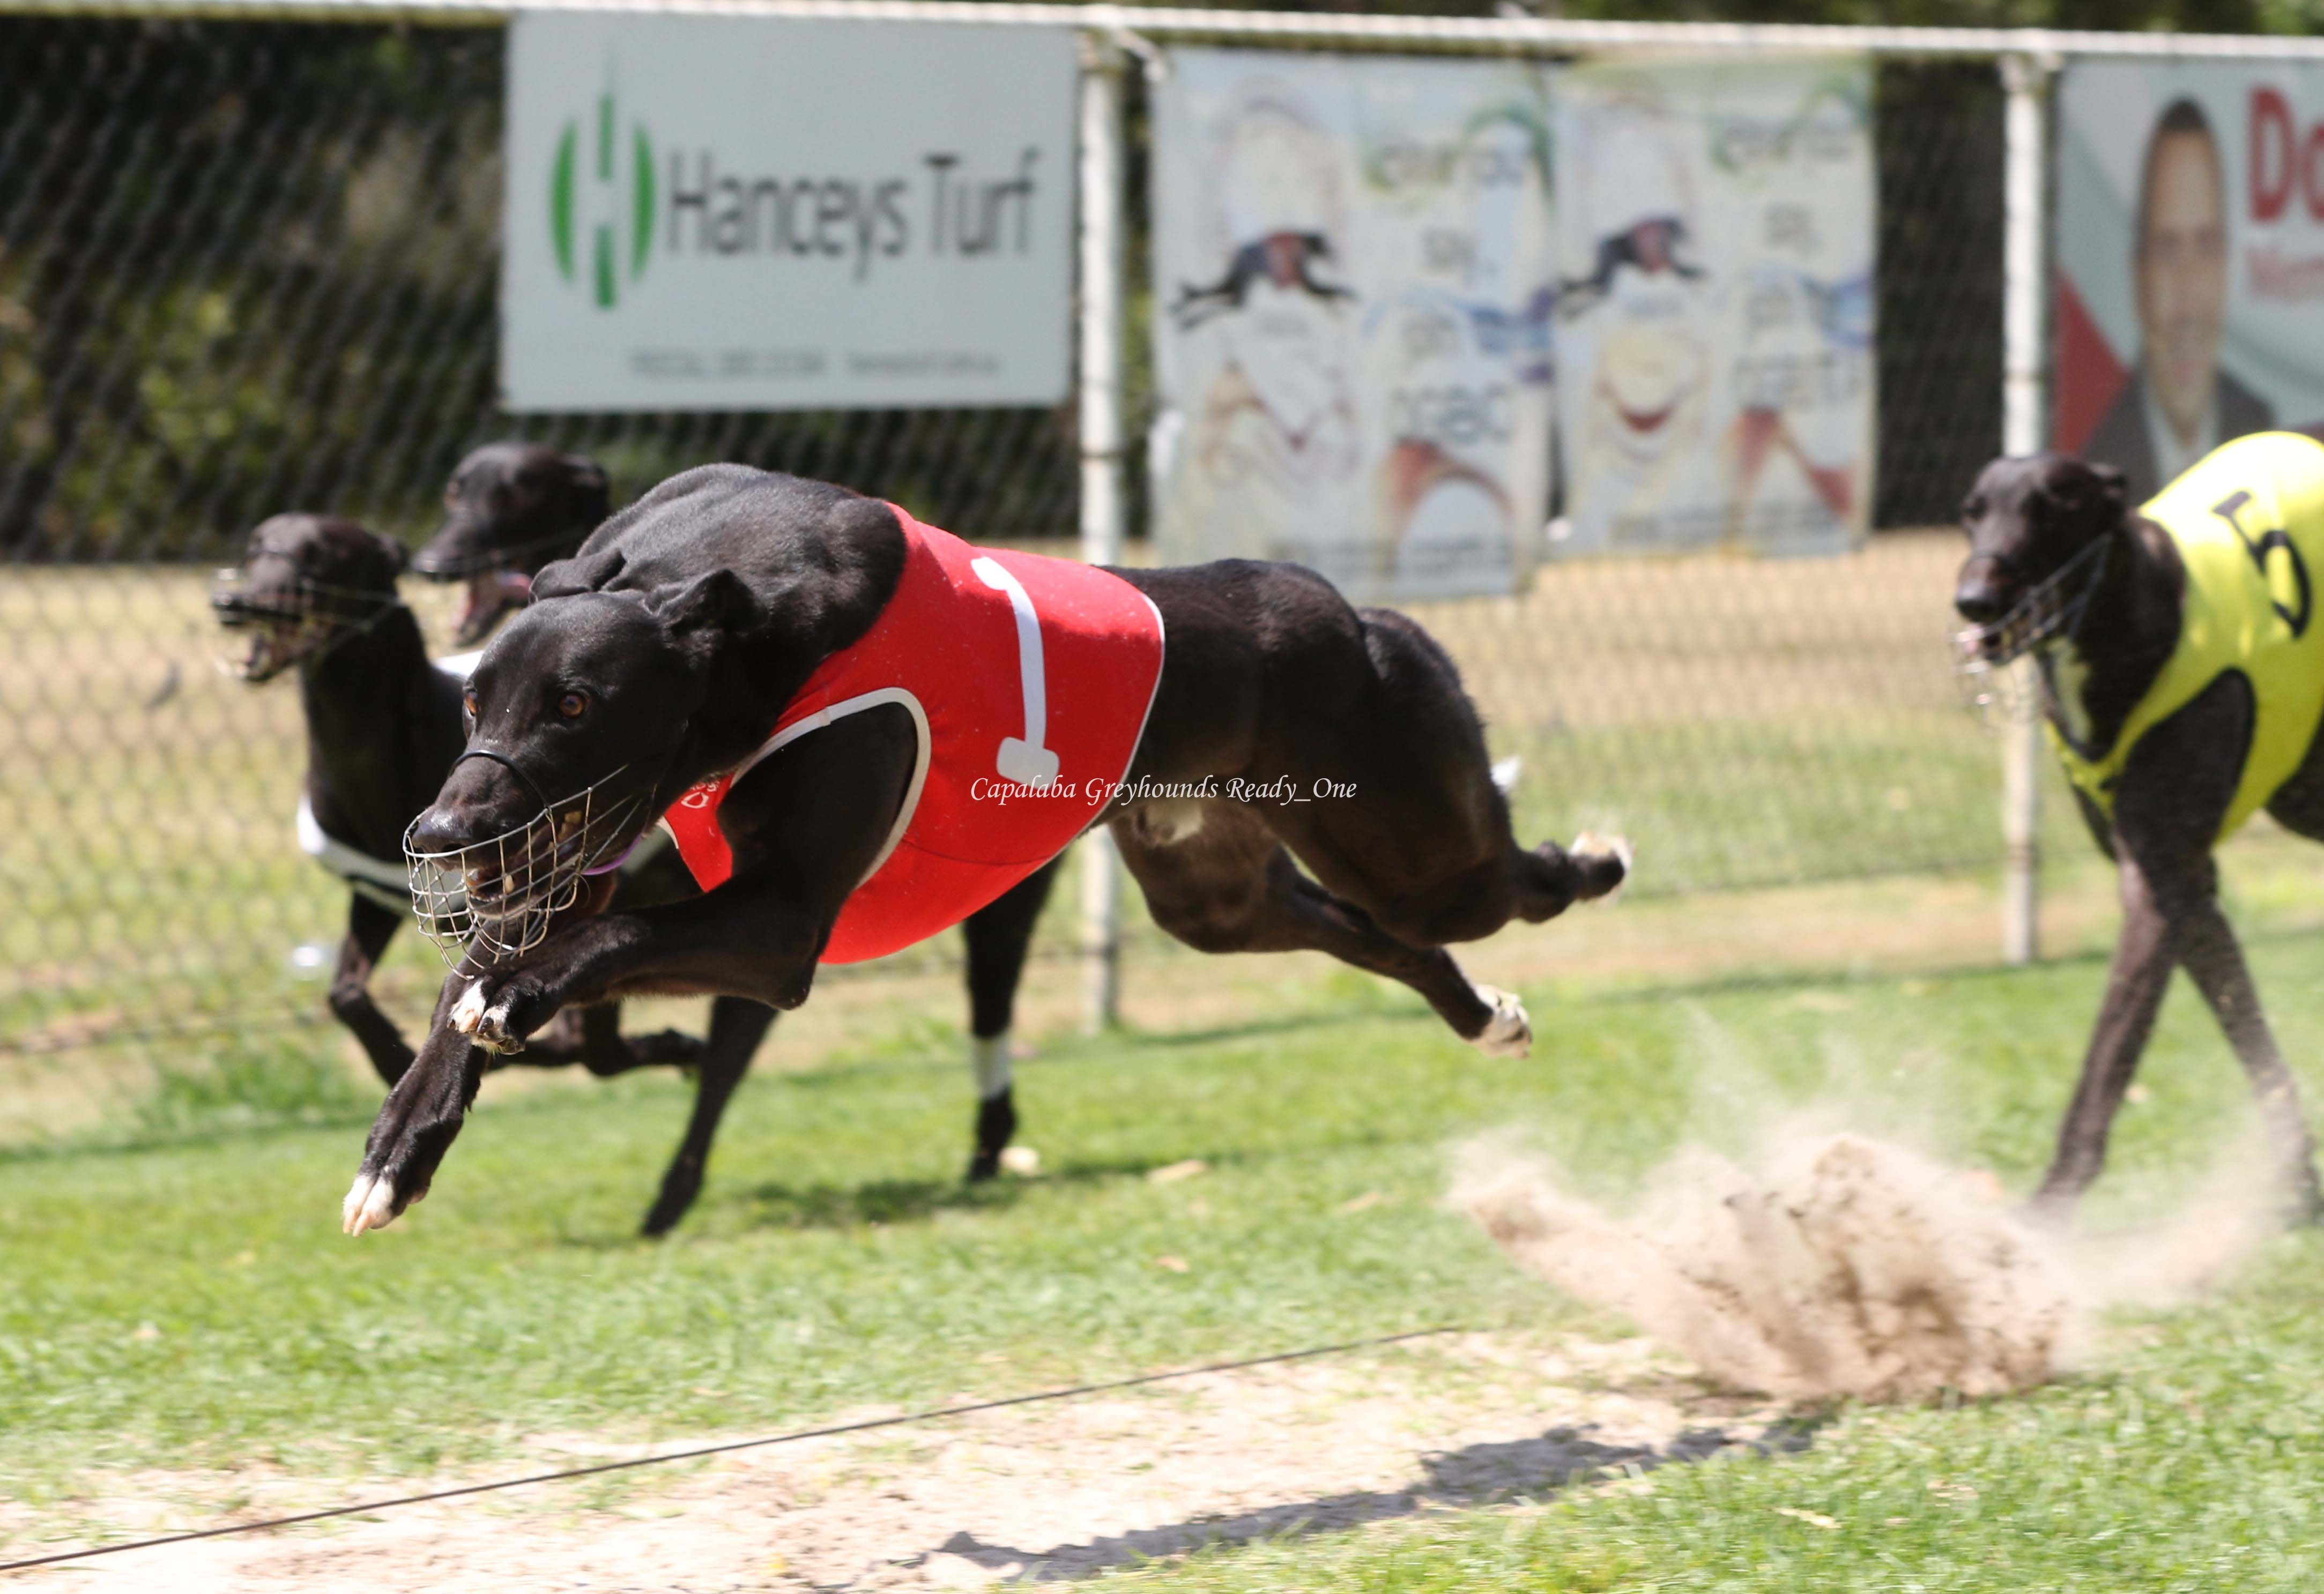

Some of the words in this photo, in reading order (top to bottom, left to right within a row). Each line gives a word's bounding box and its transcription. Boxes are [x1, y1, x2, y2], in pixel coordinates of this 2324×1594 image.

[665, 150, 910, 284] Hanceys
[923, 145, 1041, 257] Turf
[2212, 490, 2312, 638] 5
[971, 556, 1060, 789] 1
